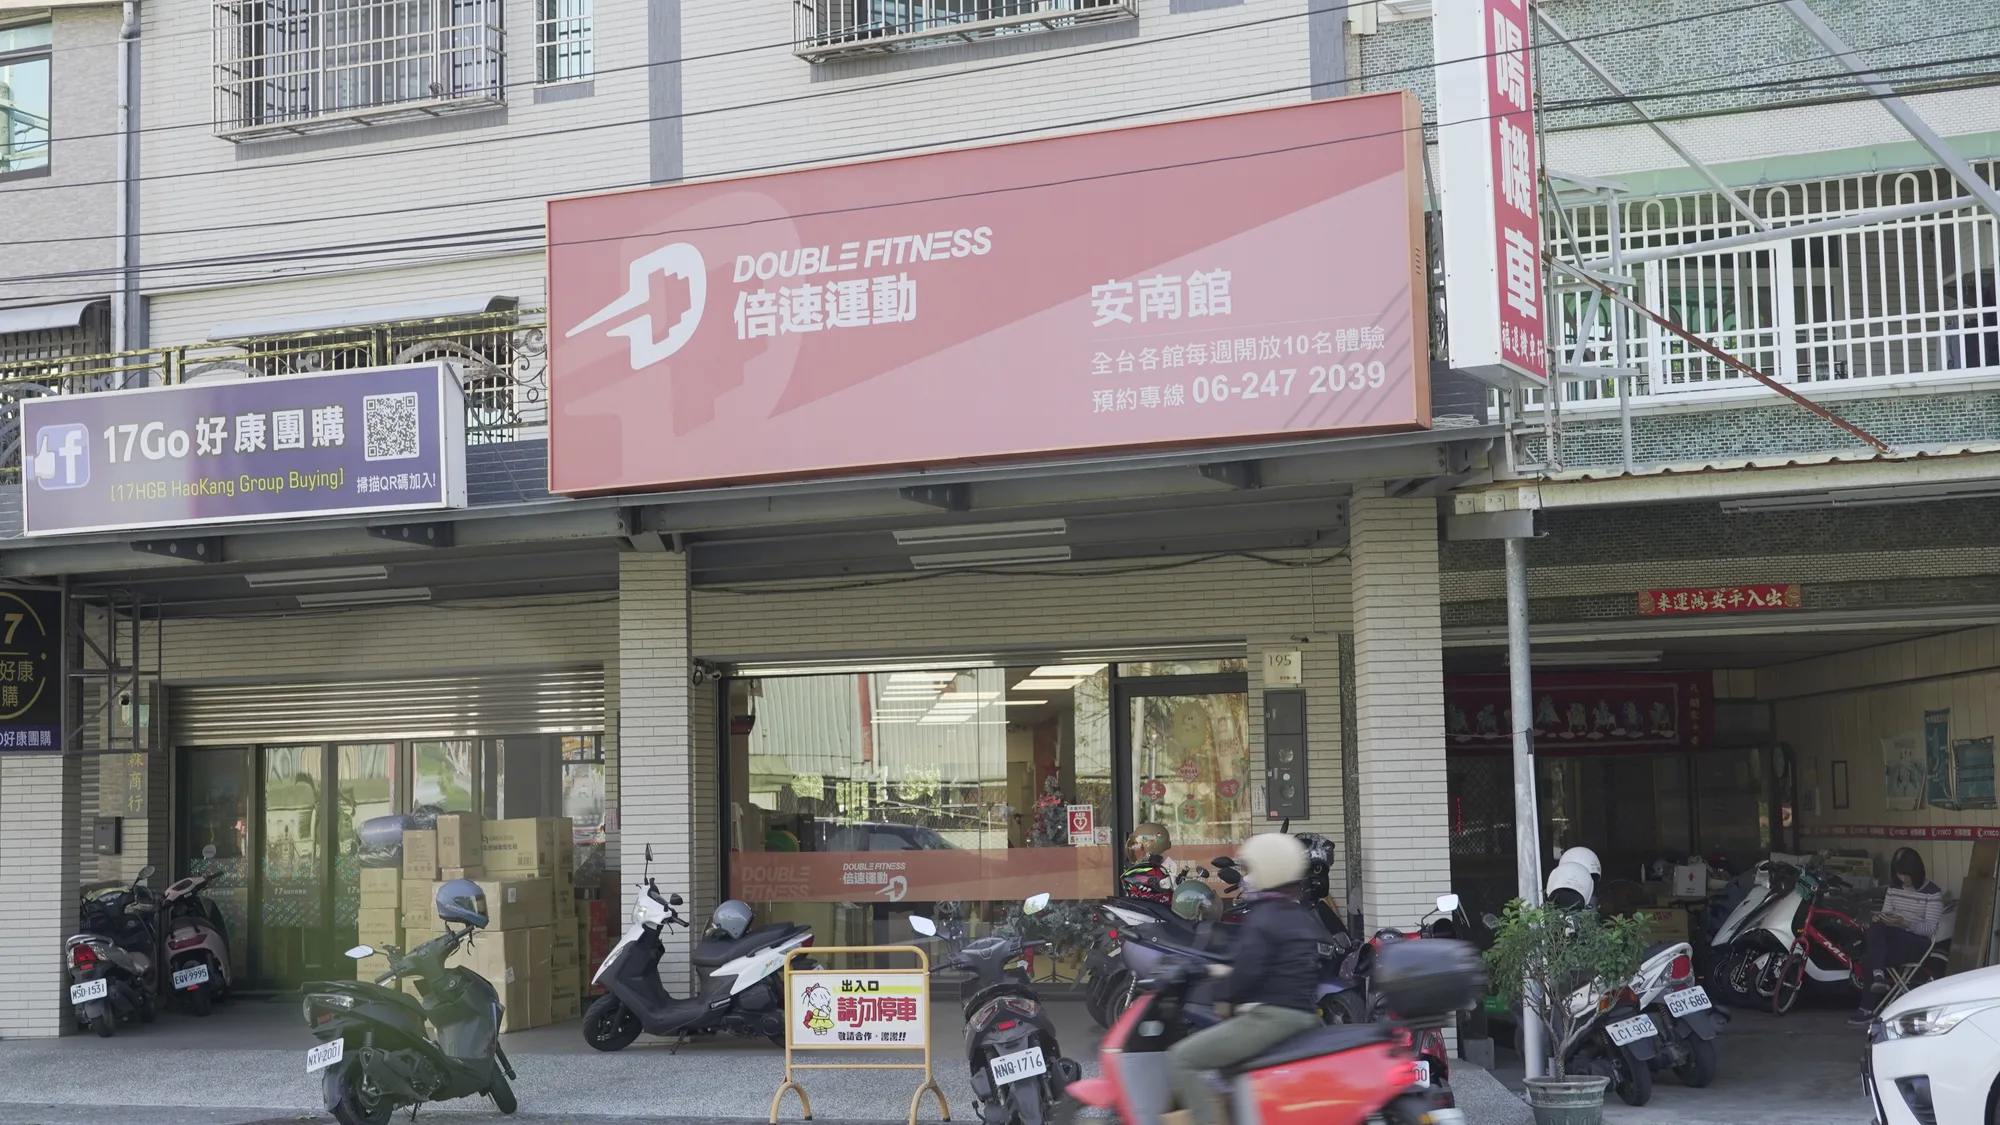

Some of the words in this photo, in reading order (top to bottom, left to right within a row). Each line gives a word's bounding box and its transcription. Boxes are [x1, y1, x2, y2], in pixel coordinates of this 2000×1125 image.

[1493, 0, 1537, 320] 陽機車
[733, 242, 860, 282] DOUBLE
[864, 226, 993, 267] FITNESS
[733, 272, 917, 340] 倍速運動
[1091, 267, 1232, 327] 安南館
[1091, 325, 1385, 375] 全台各館每週開放10名體驗
[1092, 383, 1185, 413] 預約專線
[1192, 368, 1297, 403] 06-247
[1309, 360, 1386, 394] 2039
[103, 420, 190, 464] 17Go
[195, 405, 345, 456] 好康團購
[172, 476, 234, 499] HaoKang
[239, 473, 284, 497] Group
[0, 661, 34, 682] 好康
[1269, 654, 1292, 667] 195
[742, 866, 810, 884] DOUBLE
[843, 862, 874, 871] DOUBLE
[875, 861, 906, 870] FITNESS
[843, 872, 888, 885] 倍速運動
[842, 979, 879, 992] 出入口
[837, 997, 917, 1027] 請勿停車
